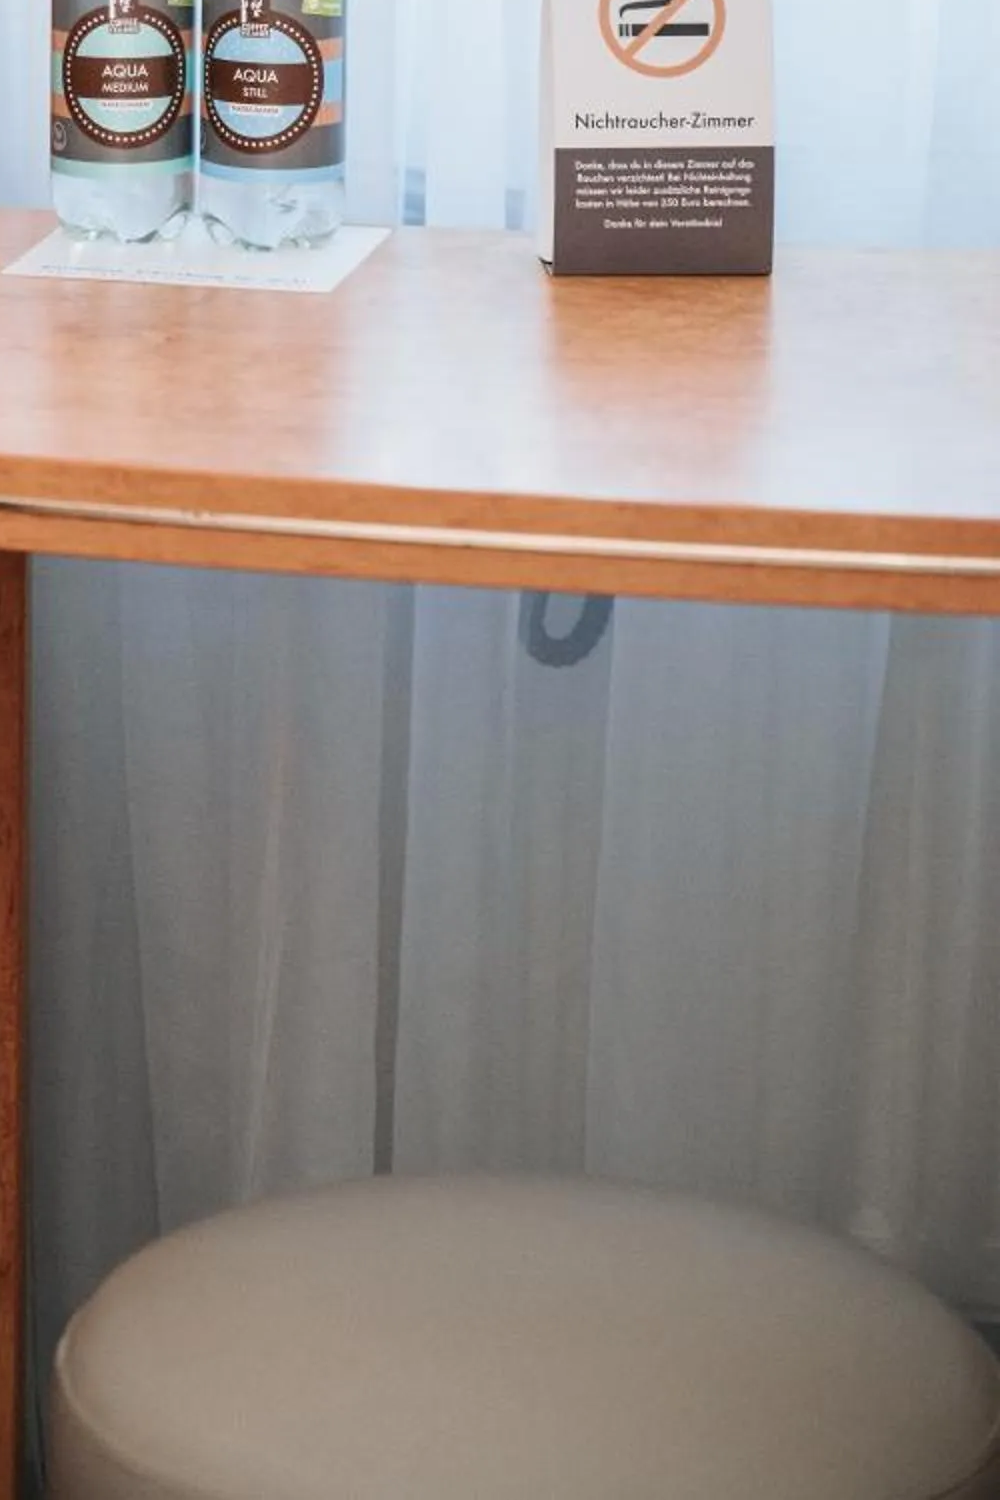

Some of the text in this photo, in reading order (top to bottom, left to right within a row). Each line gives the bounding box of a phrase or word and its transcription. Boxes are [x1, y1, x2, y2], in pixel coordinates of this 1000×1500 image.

[102, 63, 148, 78] AQUA
[233, 67, 279, 83] AQUA
[102, 82, 149, 93] MEDIUM
[243, 87, 268, 98] STILL
[575, 111, 755, 130] Nichtraucher-Zimmer
